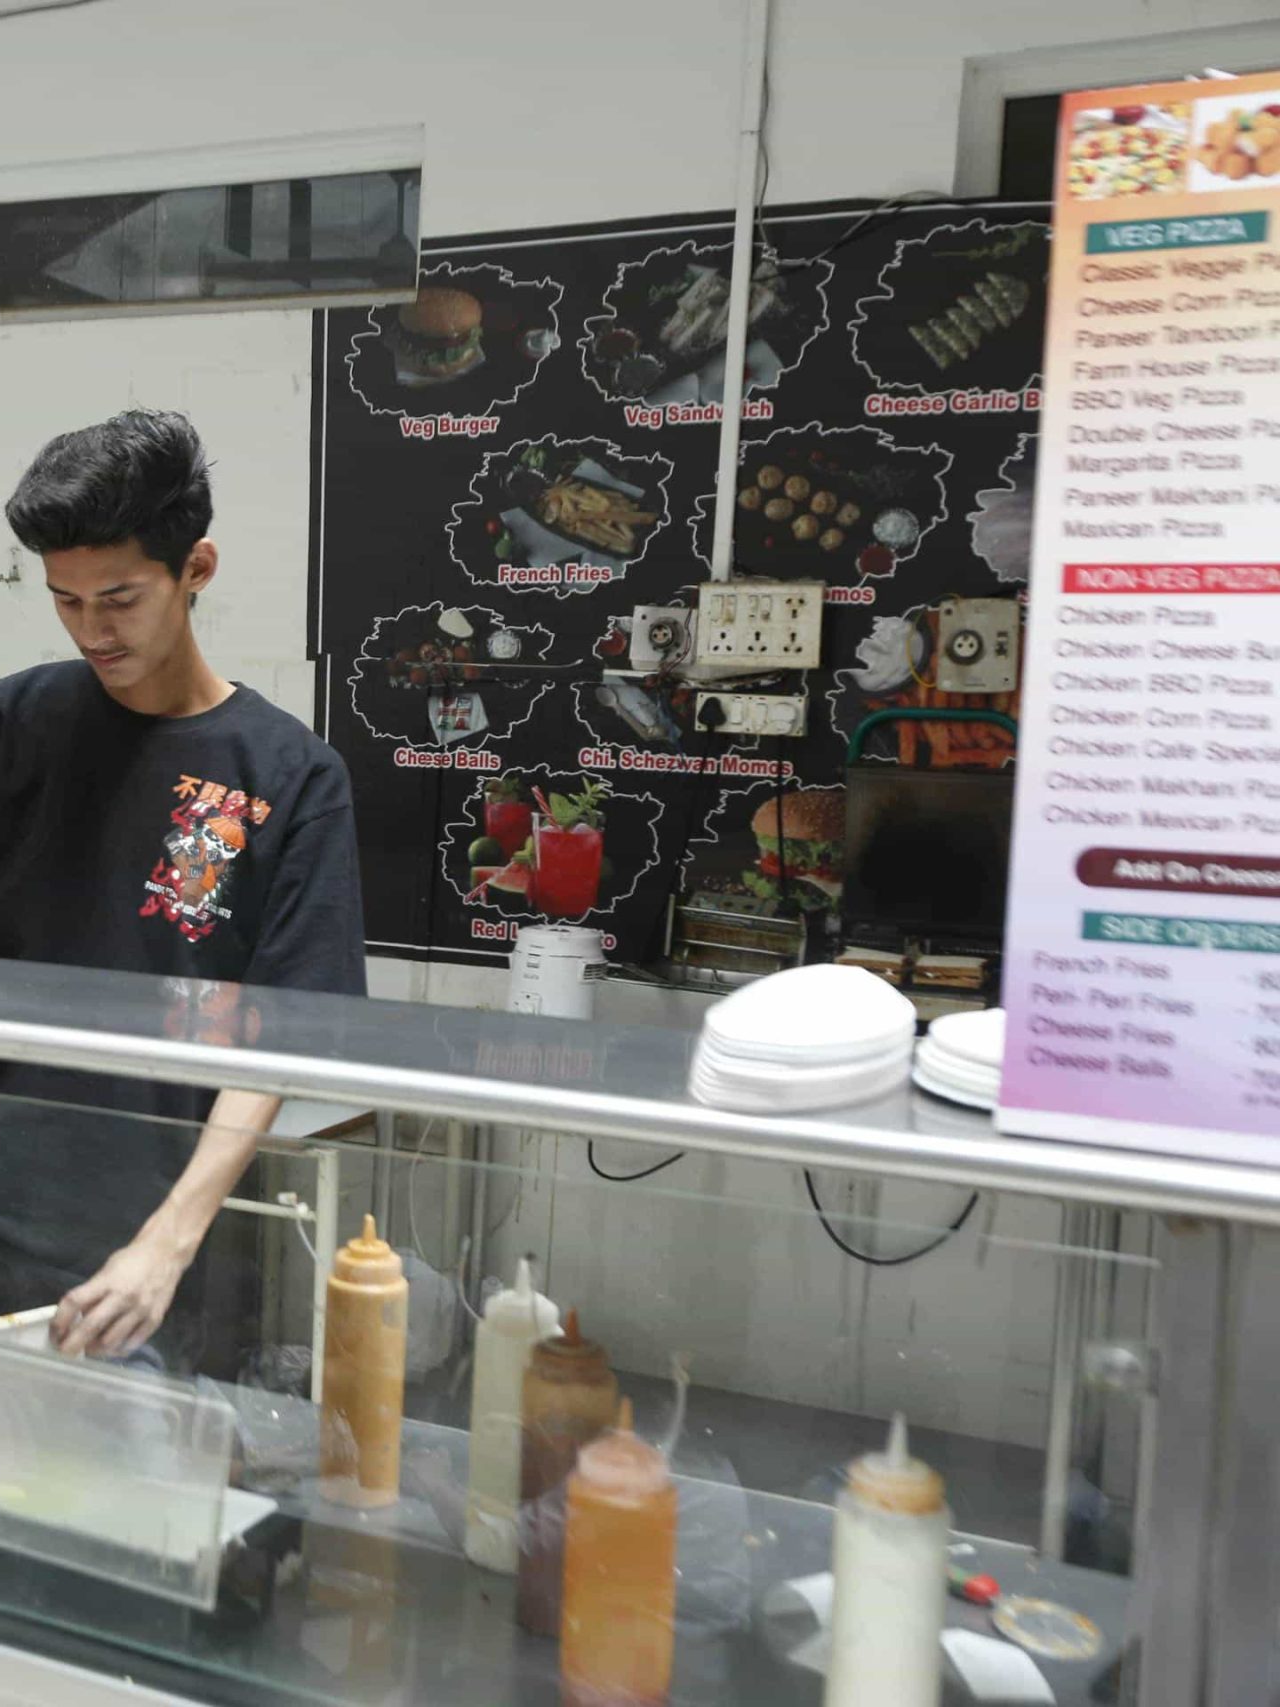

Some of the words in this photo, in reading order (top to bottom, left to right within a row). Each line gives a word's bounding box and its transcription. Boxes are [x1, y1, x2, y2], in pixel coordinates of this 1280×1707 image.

[865, 395, 946, 415] Cheese
[951, 391, 1019, 414] Garlic
[401, 418, 434, 439] Veg
[438, 415, 500, 438] Burger
[626, 406, 661, 428] Veg
[499, 565, 560, 583] French
[566, 564, 611, 582] Fries
[394, 748, 451, 768] Cheese
[456, 750, 501, 770] Balls
[578, 750, 616, 769] Chi.
[621, 752, 717, 774] Schezwan
[720, 755, 794, 777] Momos
[472, 919, 507, 940] Red
